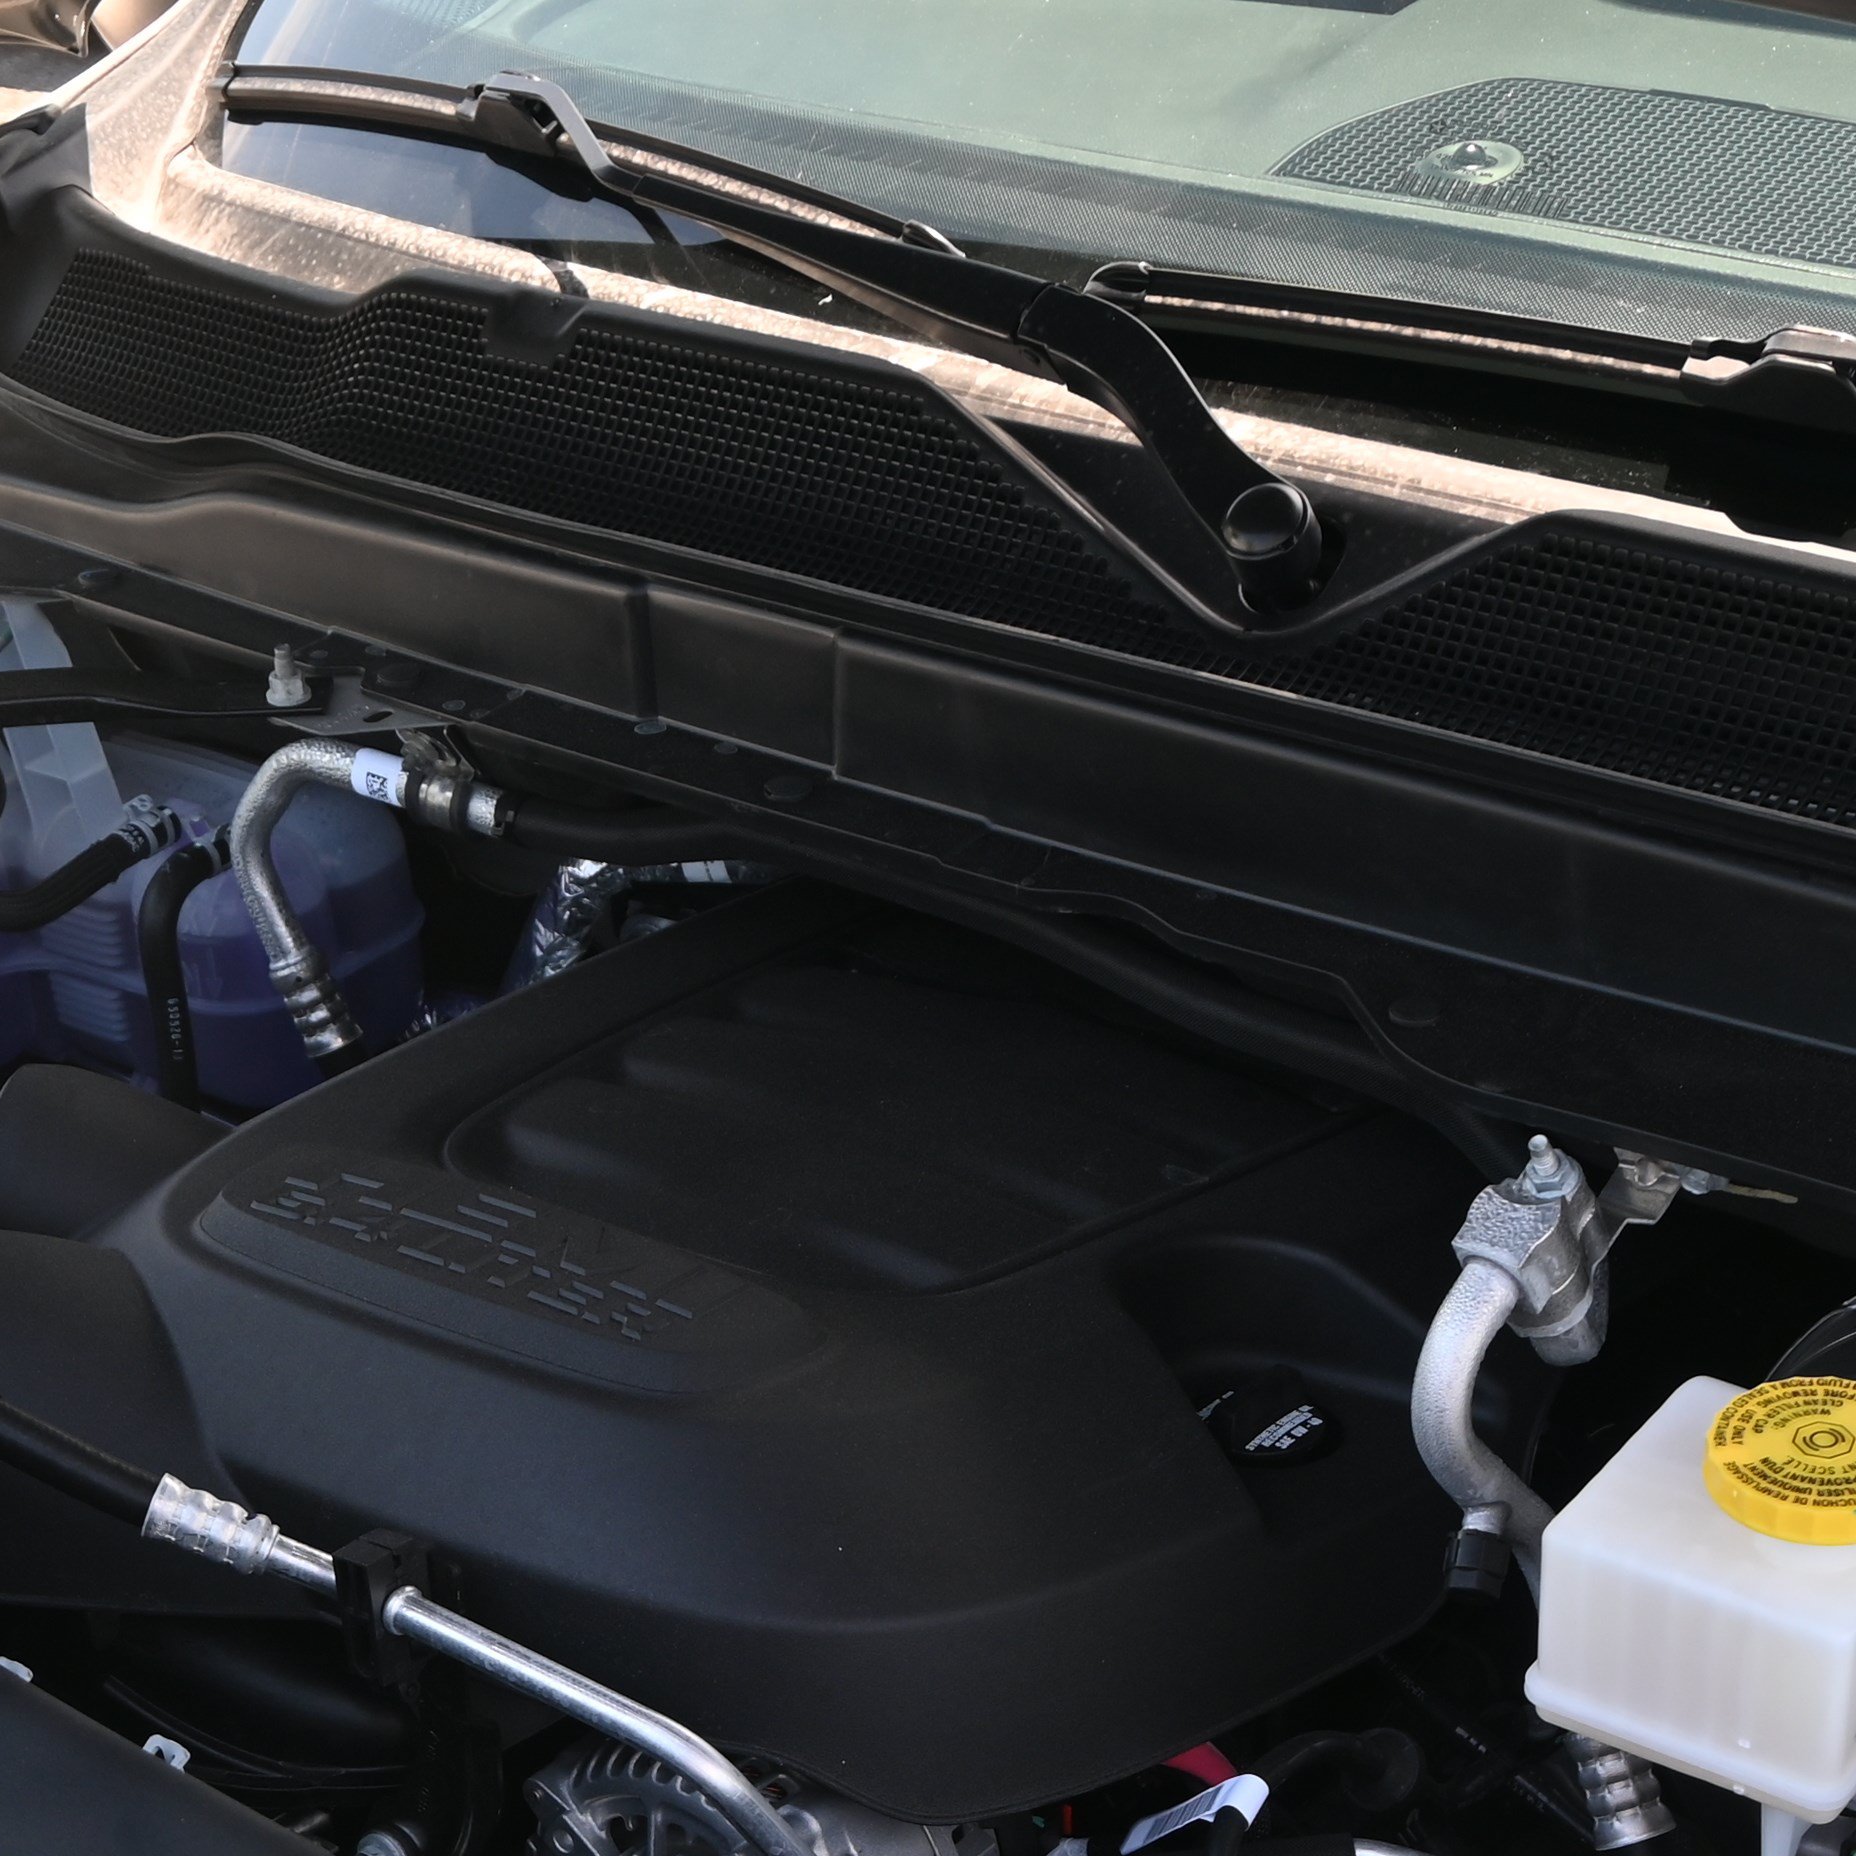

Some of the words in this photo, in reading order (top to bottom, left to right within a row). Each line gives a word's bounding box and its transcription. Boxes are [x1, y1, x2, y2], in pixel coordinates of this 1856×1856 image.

[1780, 1378, 1811, 1389] FROM
[1812, 1378, 1844, 1389] FLUID
[1733, 1385, 1769, 1406] SEALED
[1803, 1399, 1843, 1409] CLEAN
[1739, 1409, 1757, 1424] USE
[1768, 1400, 1802, 1420] FILLER
[1712, 1405, 1738, 1448] CONTAINER
[1730, 1423, 1747, 1446] ONLY
[1750, 1417, 1769, 1434] CAP
[1722, 1461, 1791, 1503] REMPLISSAGE
[1742, 1461, 1813, 1494] UNIQUEMENT
[1792, 1495, 1808, 1506] DE
